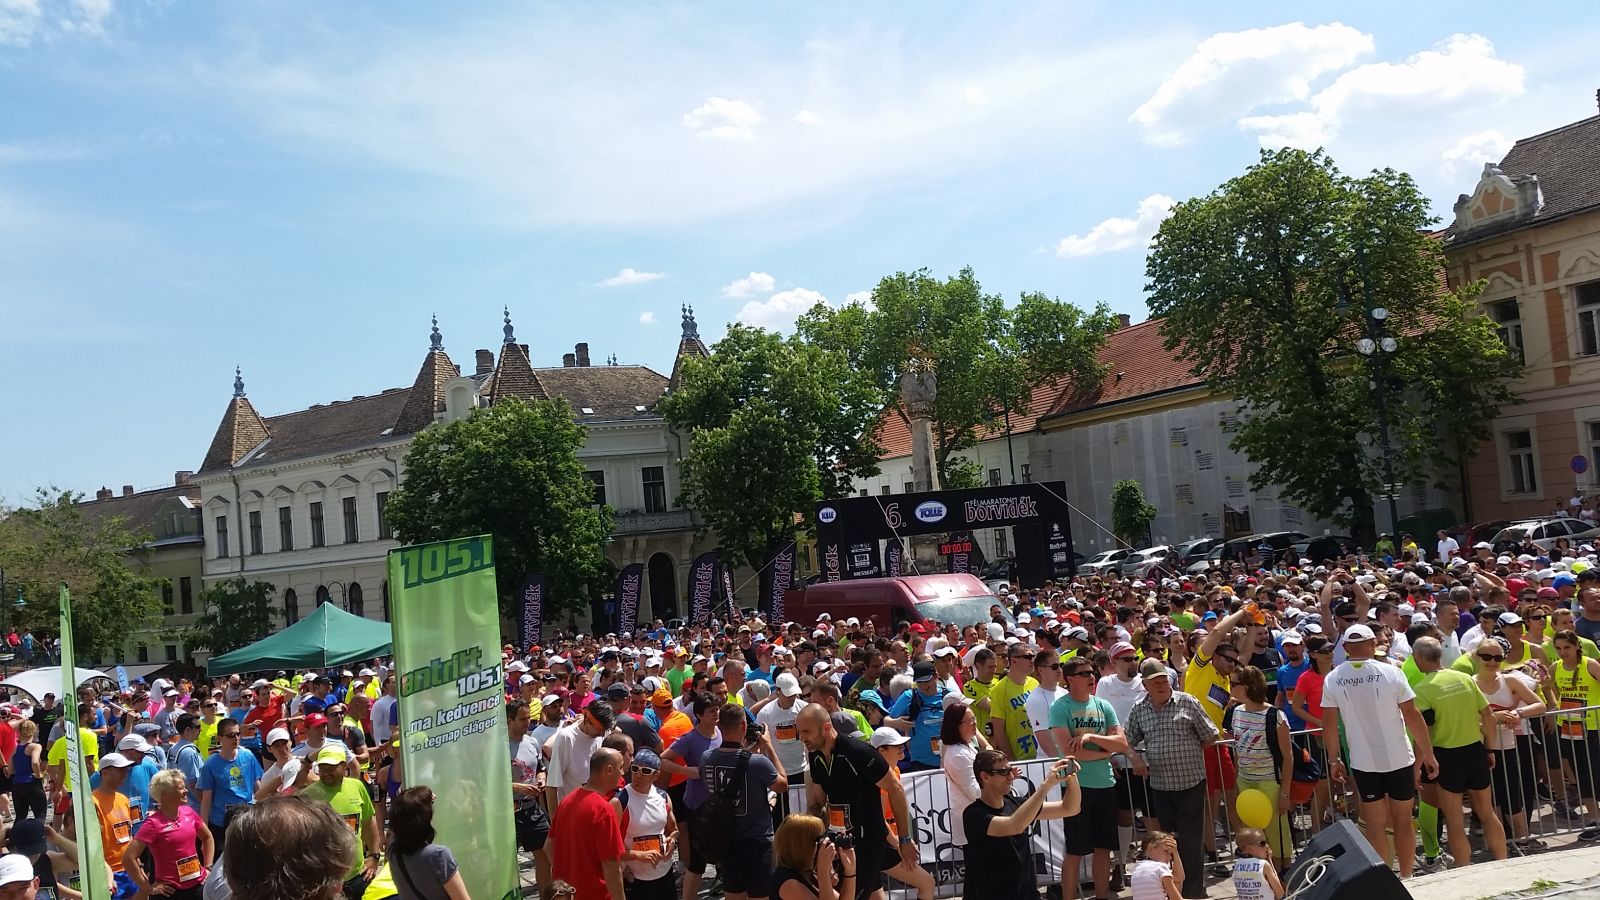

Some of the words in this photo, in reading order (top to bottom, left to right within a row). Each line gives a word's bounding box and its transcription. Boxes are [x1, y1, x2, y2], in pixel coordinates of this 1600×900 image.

[964, 496, 1039, 523] borvidék
[402, 537, 494, 589] 105.1
[401, 646, 482, 697] antritt
[456, 663, 501, 698] 105.1
[1336, 677, 1364, 687] Rooga
[1366, 674, 1383, 684] BT
[423, 728, 461, 749] tegnap
